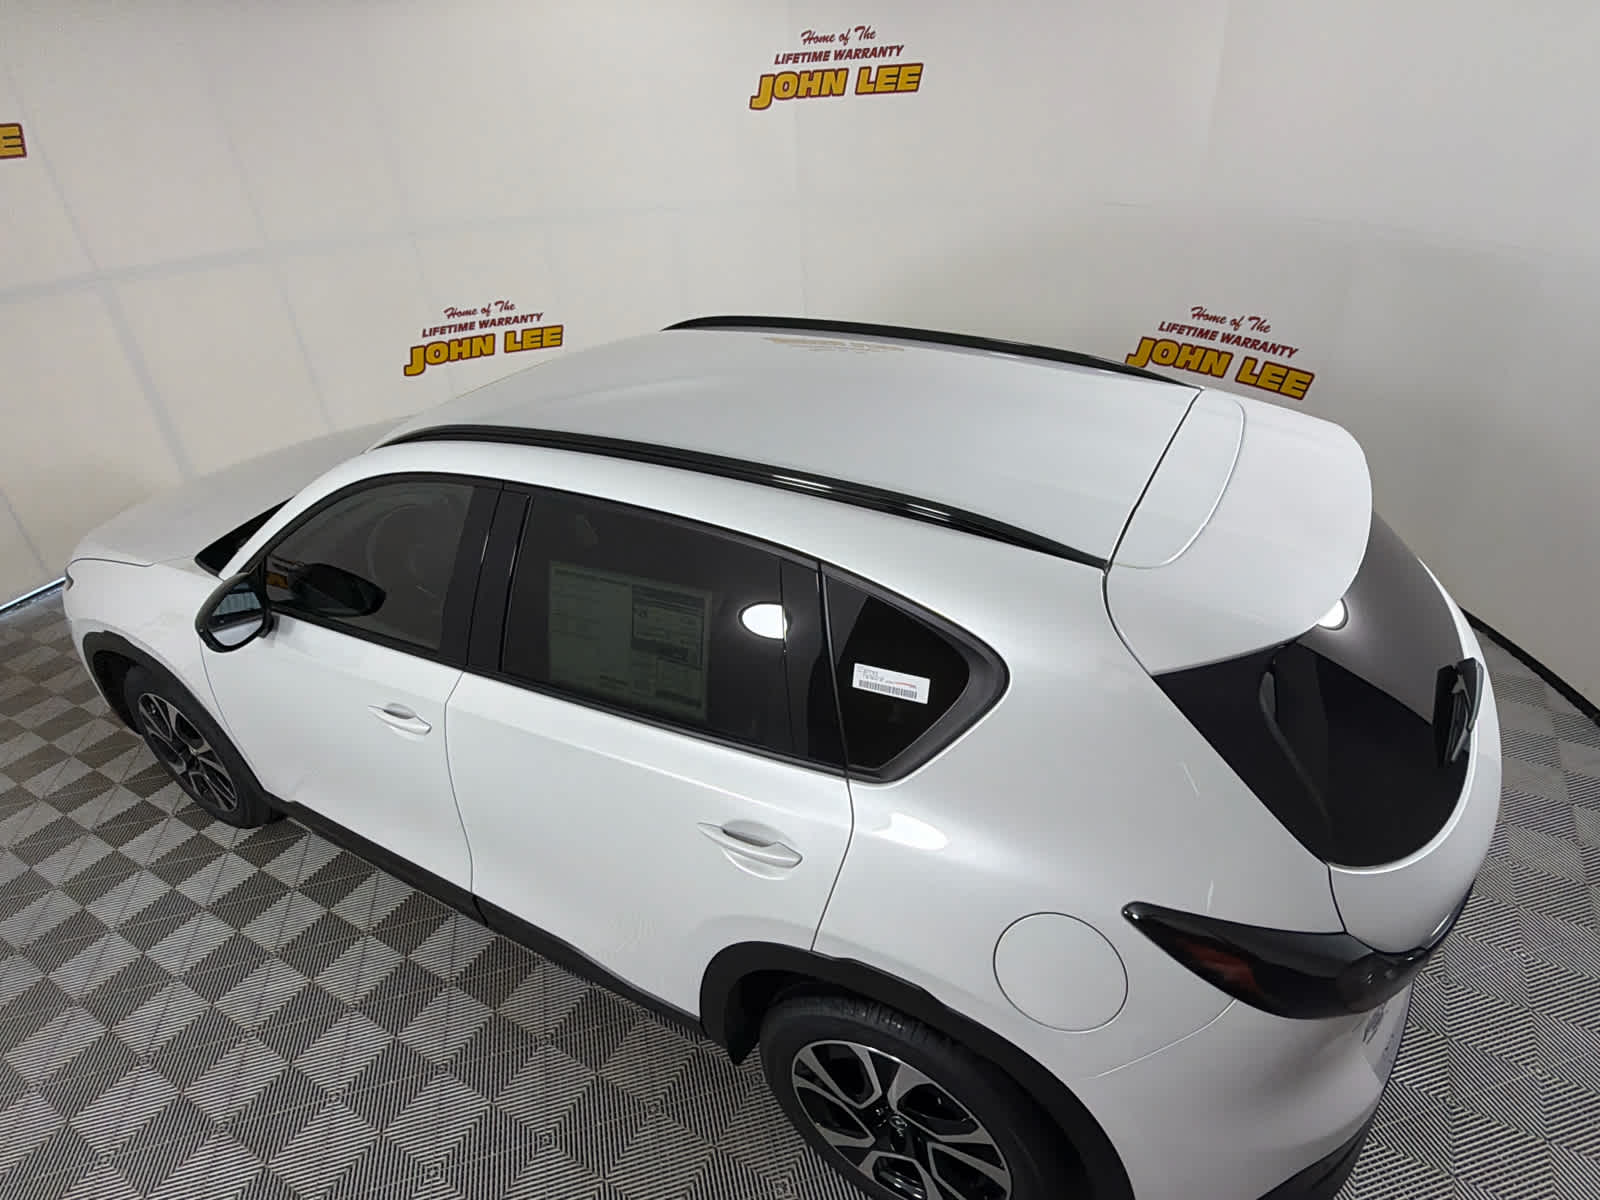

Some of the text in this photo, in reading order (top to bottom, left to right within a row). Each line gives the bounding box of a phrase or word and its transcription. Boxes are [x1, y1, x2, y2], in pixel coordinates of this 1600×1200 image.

[801, 25, 876, 45] Home of The
[774, 45, 904, 65] LIFETIME WARRANTY
[749, 63, 924, 110] JOHN LEE
[443, 300, 516, 319] Home of The
[1191, 306, 1272, 333] Home of The
[422, 313, 543, 338] LIFETIME WARRANTY
[404, 325, 563, 376] JOHN LEE
[1158, 321, 1299, 358] LIFETIME WARRANTY
[1125, 336, 1315, 400] JOHN LEE
